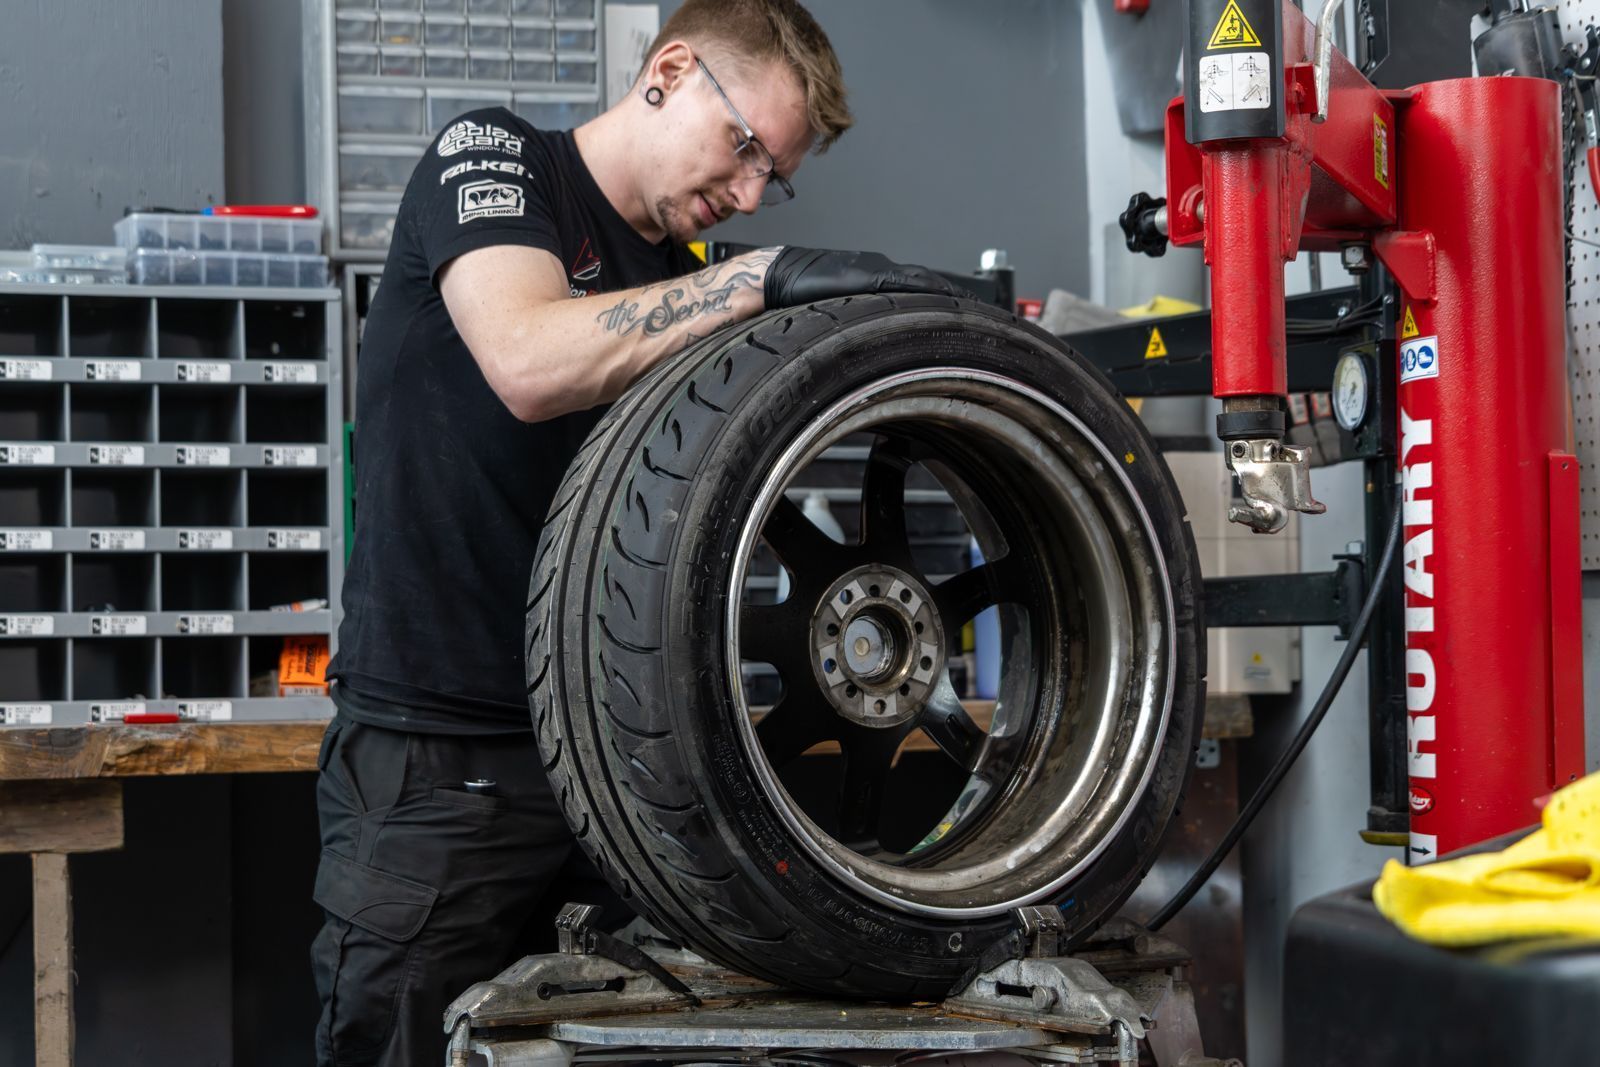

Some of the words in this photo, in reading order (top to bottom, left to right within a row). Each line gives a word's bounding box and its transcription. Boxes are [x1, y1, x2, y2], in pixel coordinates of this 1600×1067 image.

[487, 208, 520, 216] LININGS
[597, 299, 641, 337] the
[643, 283, 738, 337] Secret
[1400, 406, 1438, 778] ROTARY
